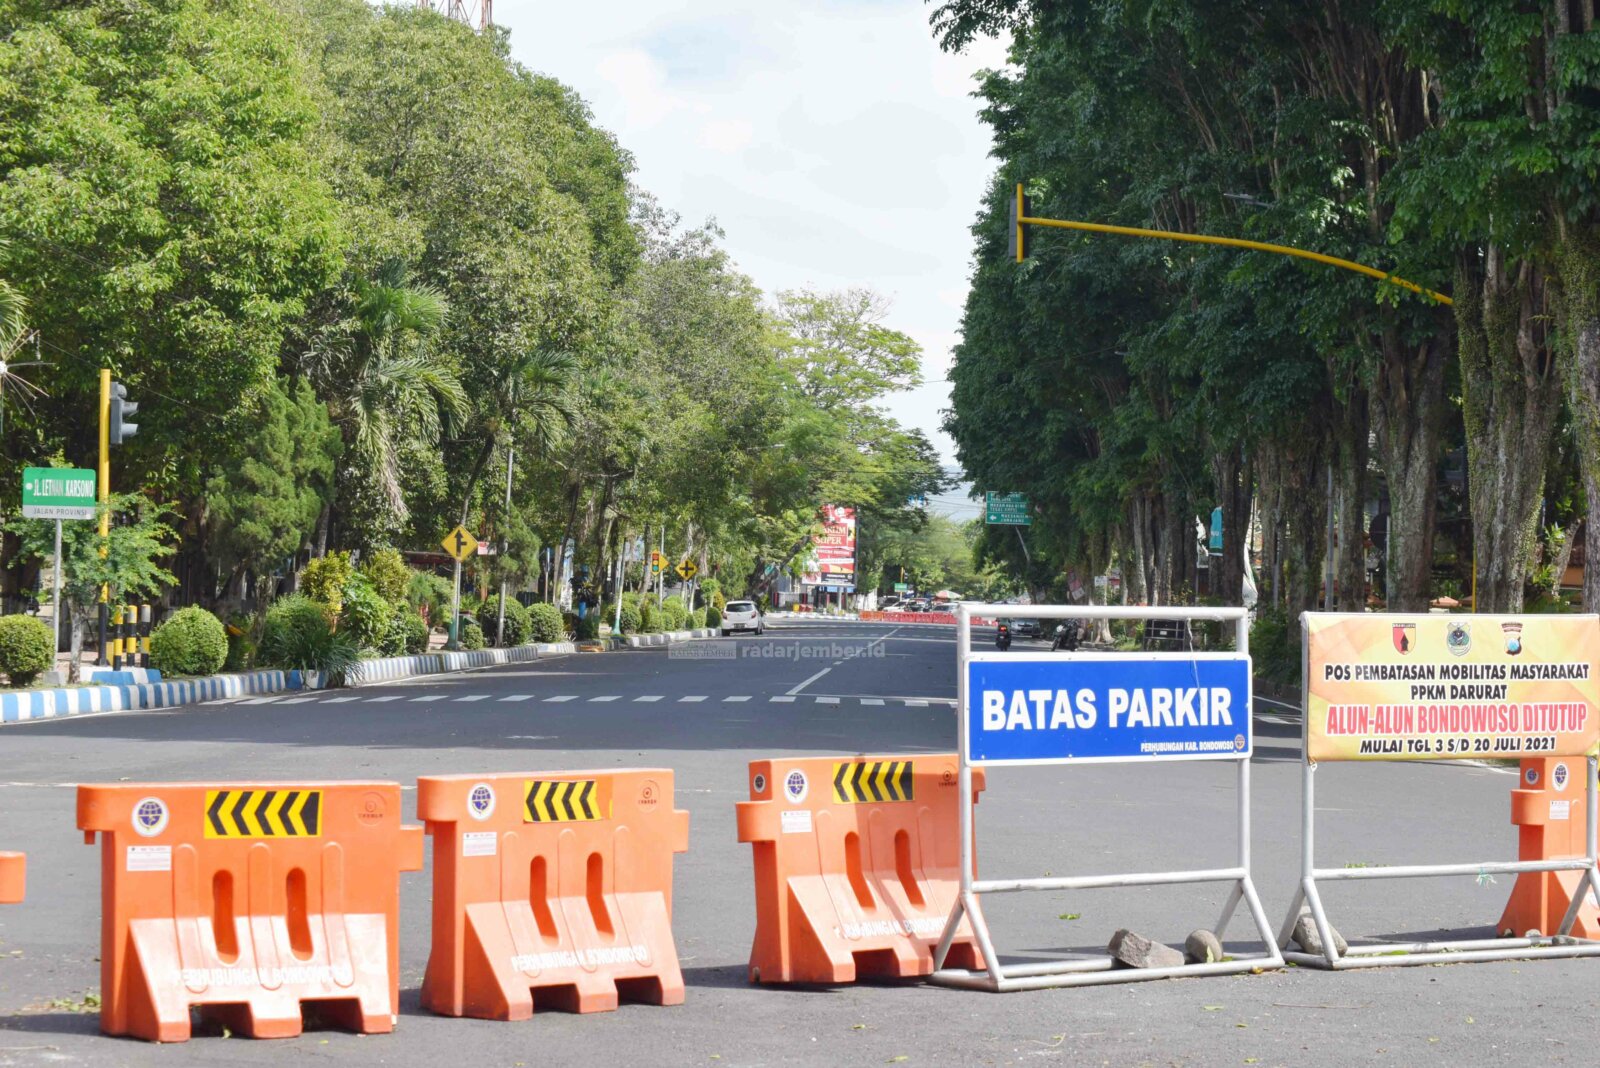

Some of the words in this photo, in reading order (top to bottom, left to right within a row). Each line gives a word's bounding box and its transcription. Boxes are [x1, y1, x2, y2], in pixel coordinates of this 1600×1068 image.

[65, 480, 94, 497] KARSONO
[33, 508, 54, 516] JALAN
[56, 508, 87, 516] PROVINSI
[815, 536, 842, 545] SUPER
[1325, 665, 1352, 681] POS
[1355, 664, 1435, 681] PEMBATASAN
[1439, 664, 1506, 681] MOBILITAS
[1509, 663, 1589, 680] MASYARAKAT
[1410, 685, 1446, 701] PPKM
[1449, 684, 1508, 700] DARURAT
[982, 688, 1097, 731] BATAS
[1108, 687, 1233, 728] PARKIR
[1326, 704, 1414, 735] ALUN-ALUN
[1417, 704, 1520, 734] BONDOWOSO
[1523, 703, 1588, 732] DITUTUP
[1140, 741, 1184, 752] PERHUBUNGAN
[1185, 741, 1198, 751] KAB.
[1199, 741, 1234, 751] BONDOWOSO
[1360, 738, 1403, 754] MULAI
[1406, 738, 1431, 753] TGL
[1435, 738, 1444, 752] 3
[1447, 738, 1471, 753] S/D
[1473, 737, 1490, 752] 20
[1493, 737, 1521, 751] JULI
[1524, 736, 1556, 751] 2021
